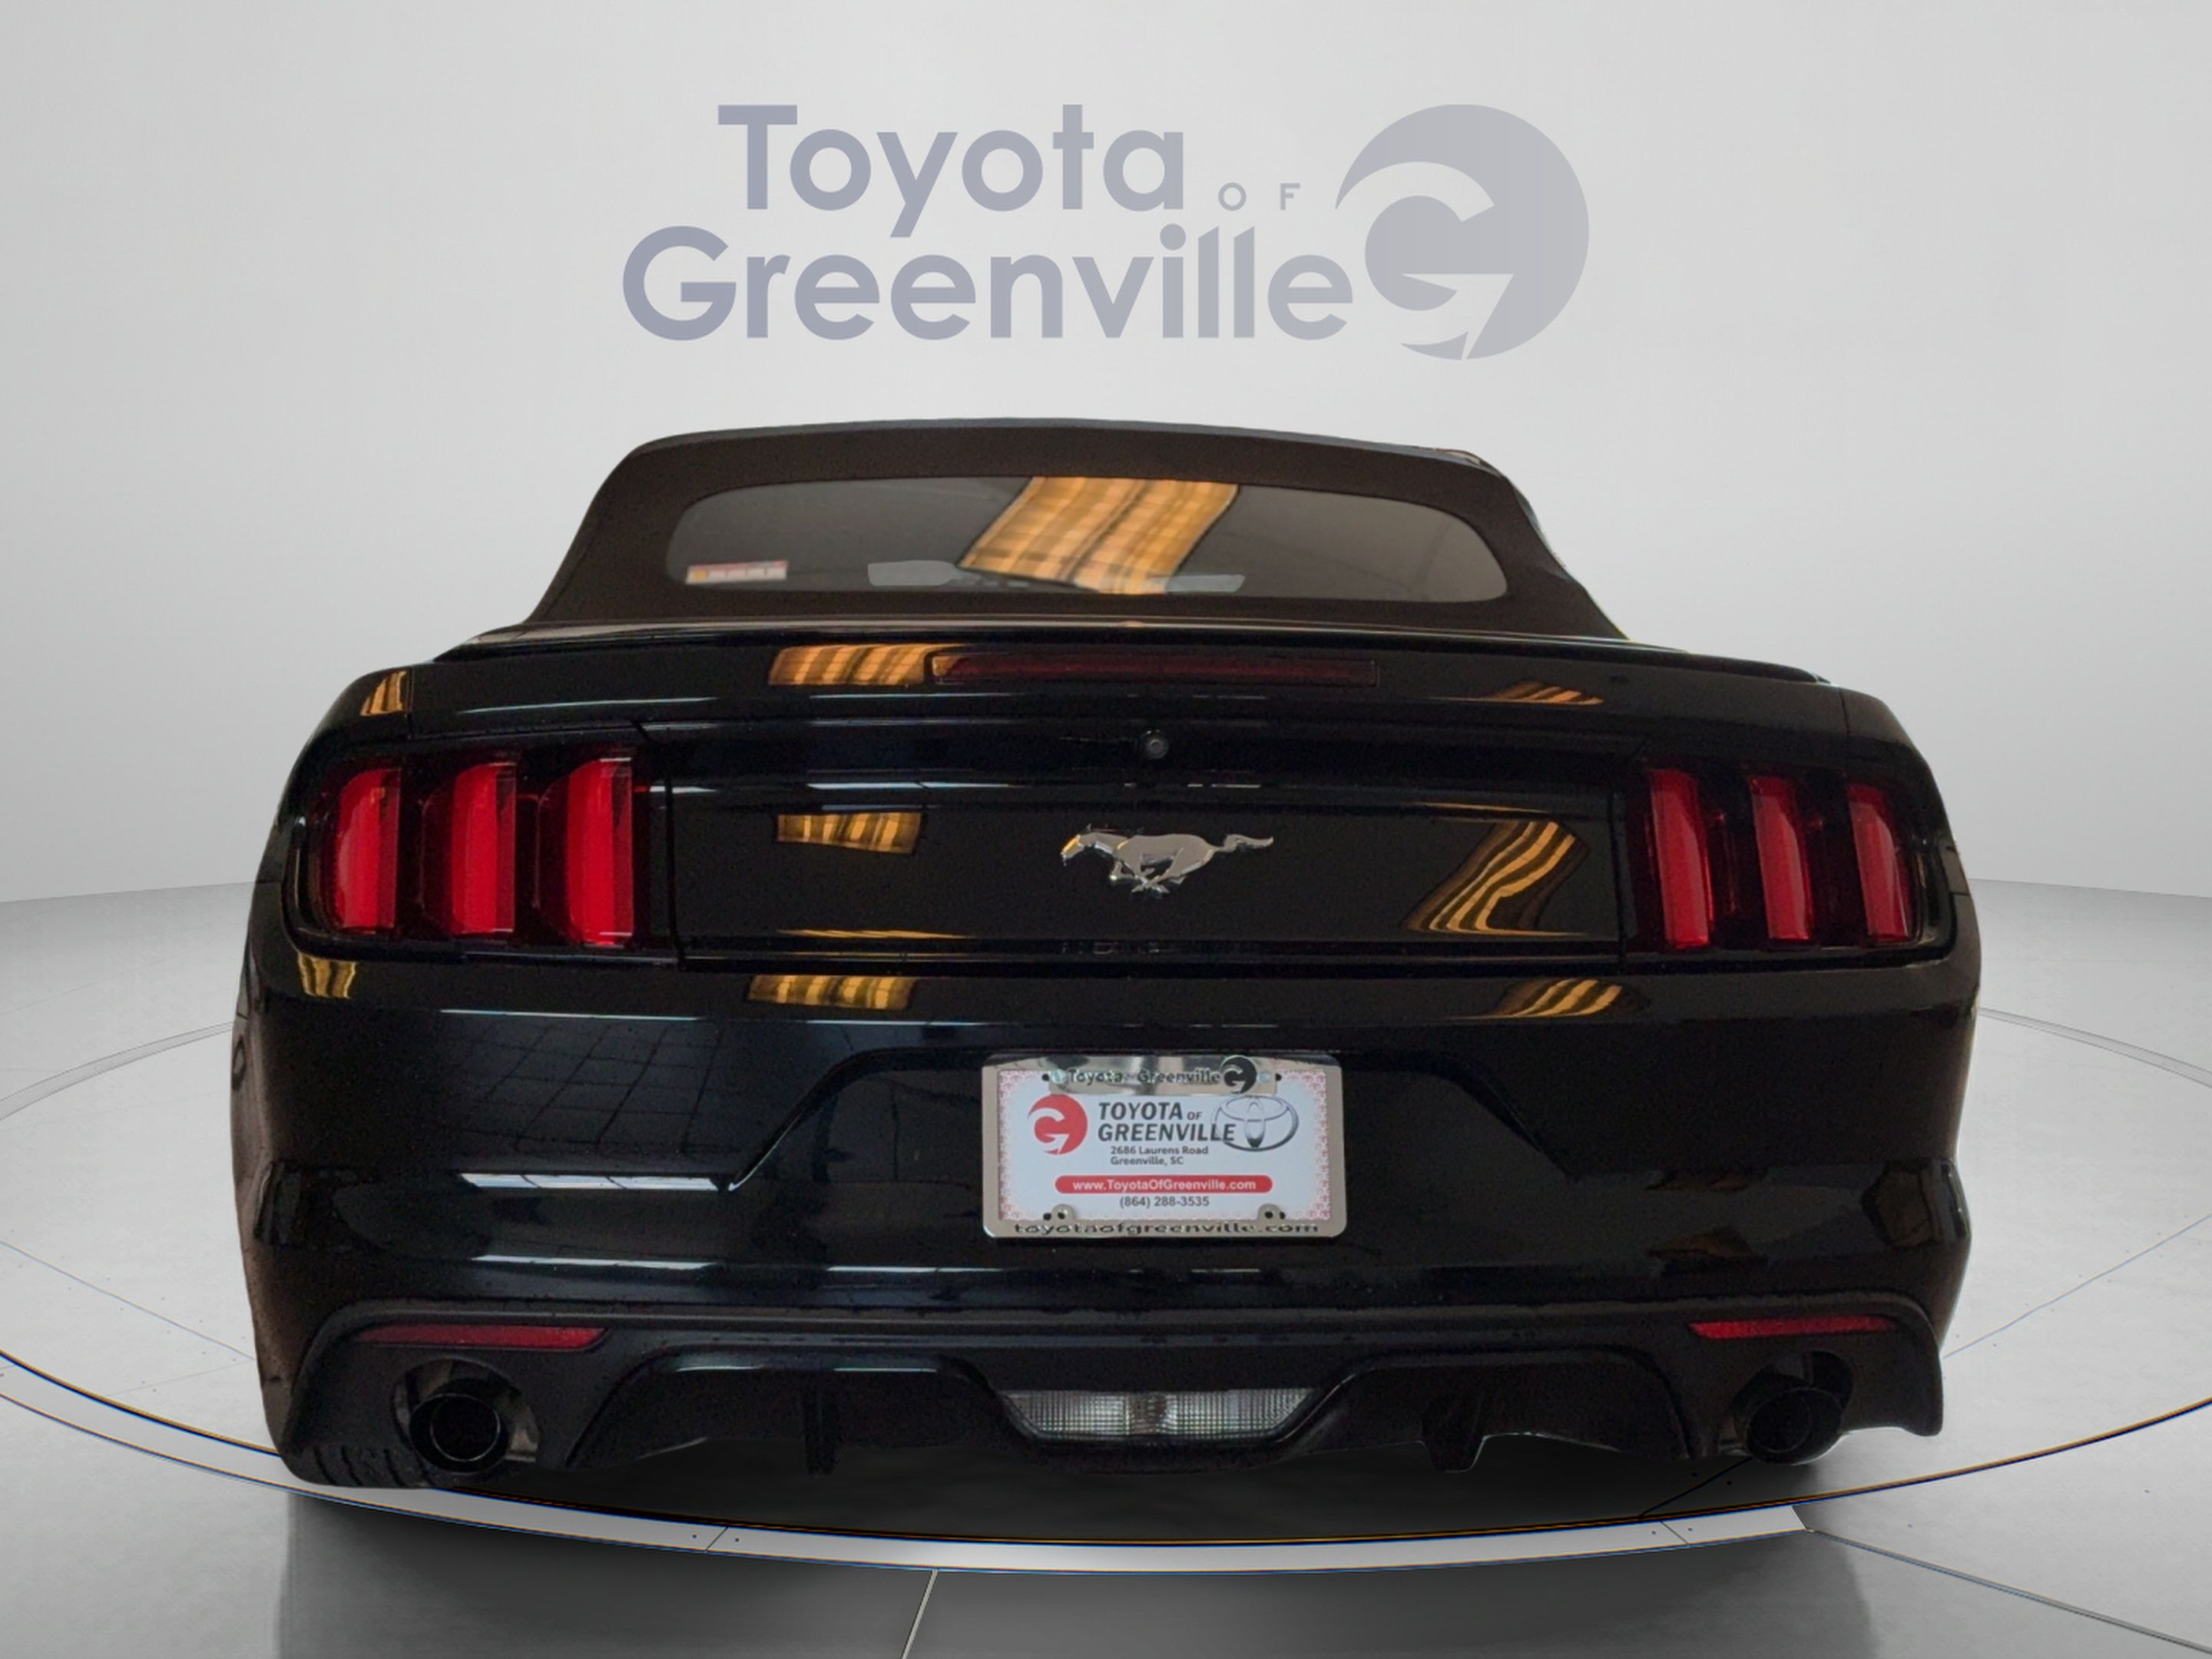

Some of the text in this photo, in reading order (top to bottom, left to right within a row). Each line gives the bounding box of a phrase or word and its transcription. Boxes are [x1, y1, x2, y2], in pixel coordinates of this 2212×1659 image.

[1068, 1070, 1123, 1085] Toyota
[1137, 1068, 1220, 1084] Greenville
[1099, 1102, 1183, 1120] TOYOTA
[1098, 1124, 1236, 1141] GREENVILLE
[1111, 1146, 1208, 1154] 2686 Laurens Road
[1111, 1157, 1184, 1166] Greenville, SC
[1073, 1179, 1256, 1191] www.ToyotaOfGreenville.com
[1120, 1197, 1210, 1208] (864) 288-3535
